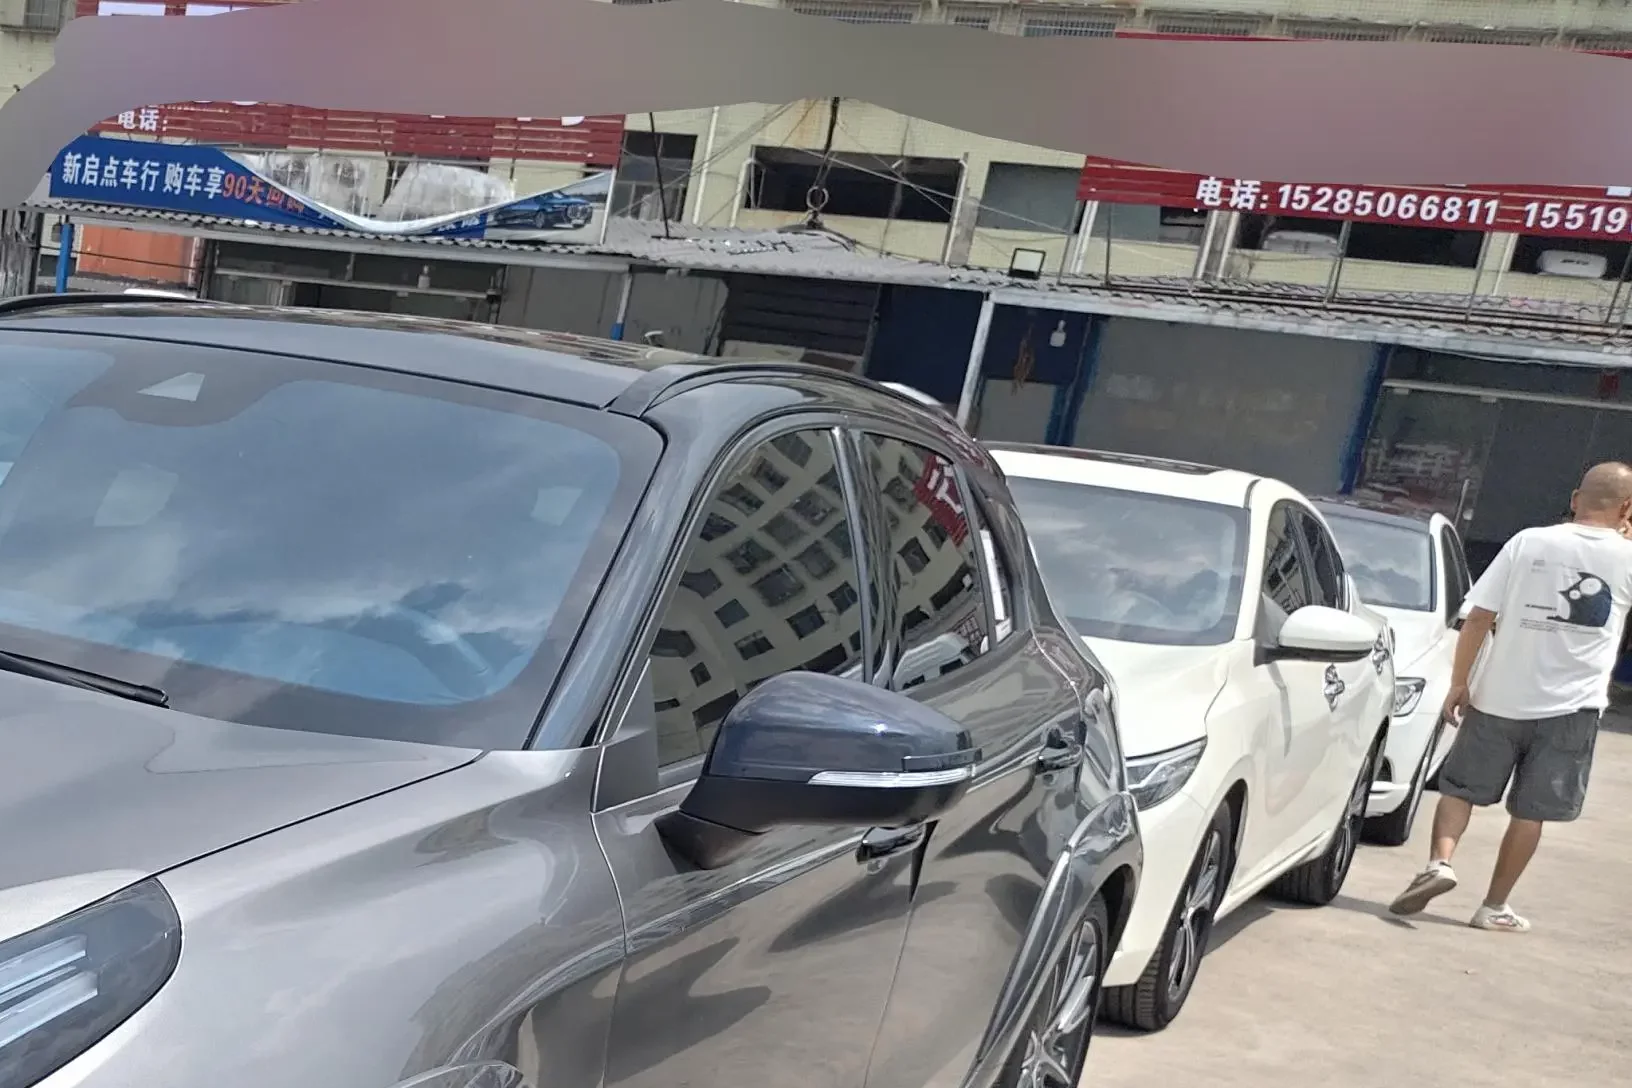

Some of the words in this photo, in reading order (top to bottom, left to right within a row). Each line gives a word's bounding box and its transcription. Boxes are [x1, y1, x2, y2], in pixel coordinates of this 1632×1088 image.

[62, 152, 160, 192] 新启点车行
[1523, 202, 1632, 234] 15519
